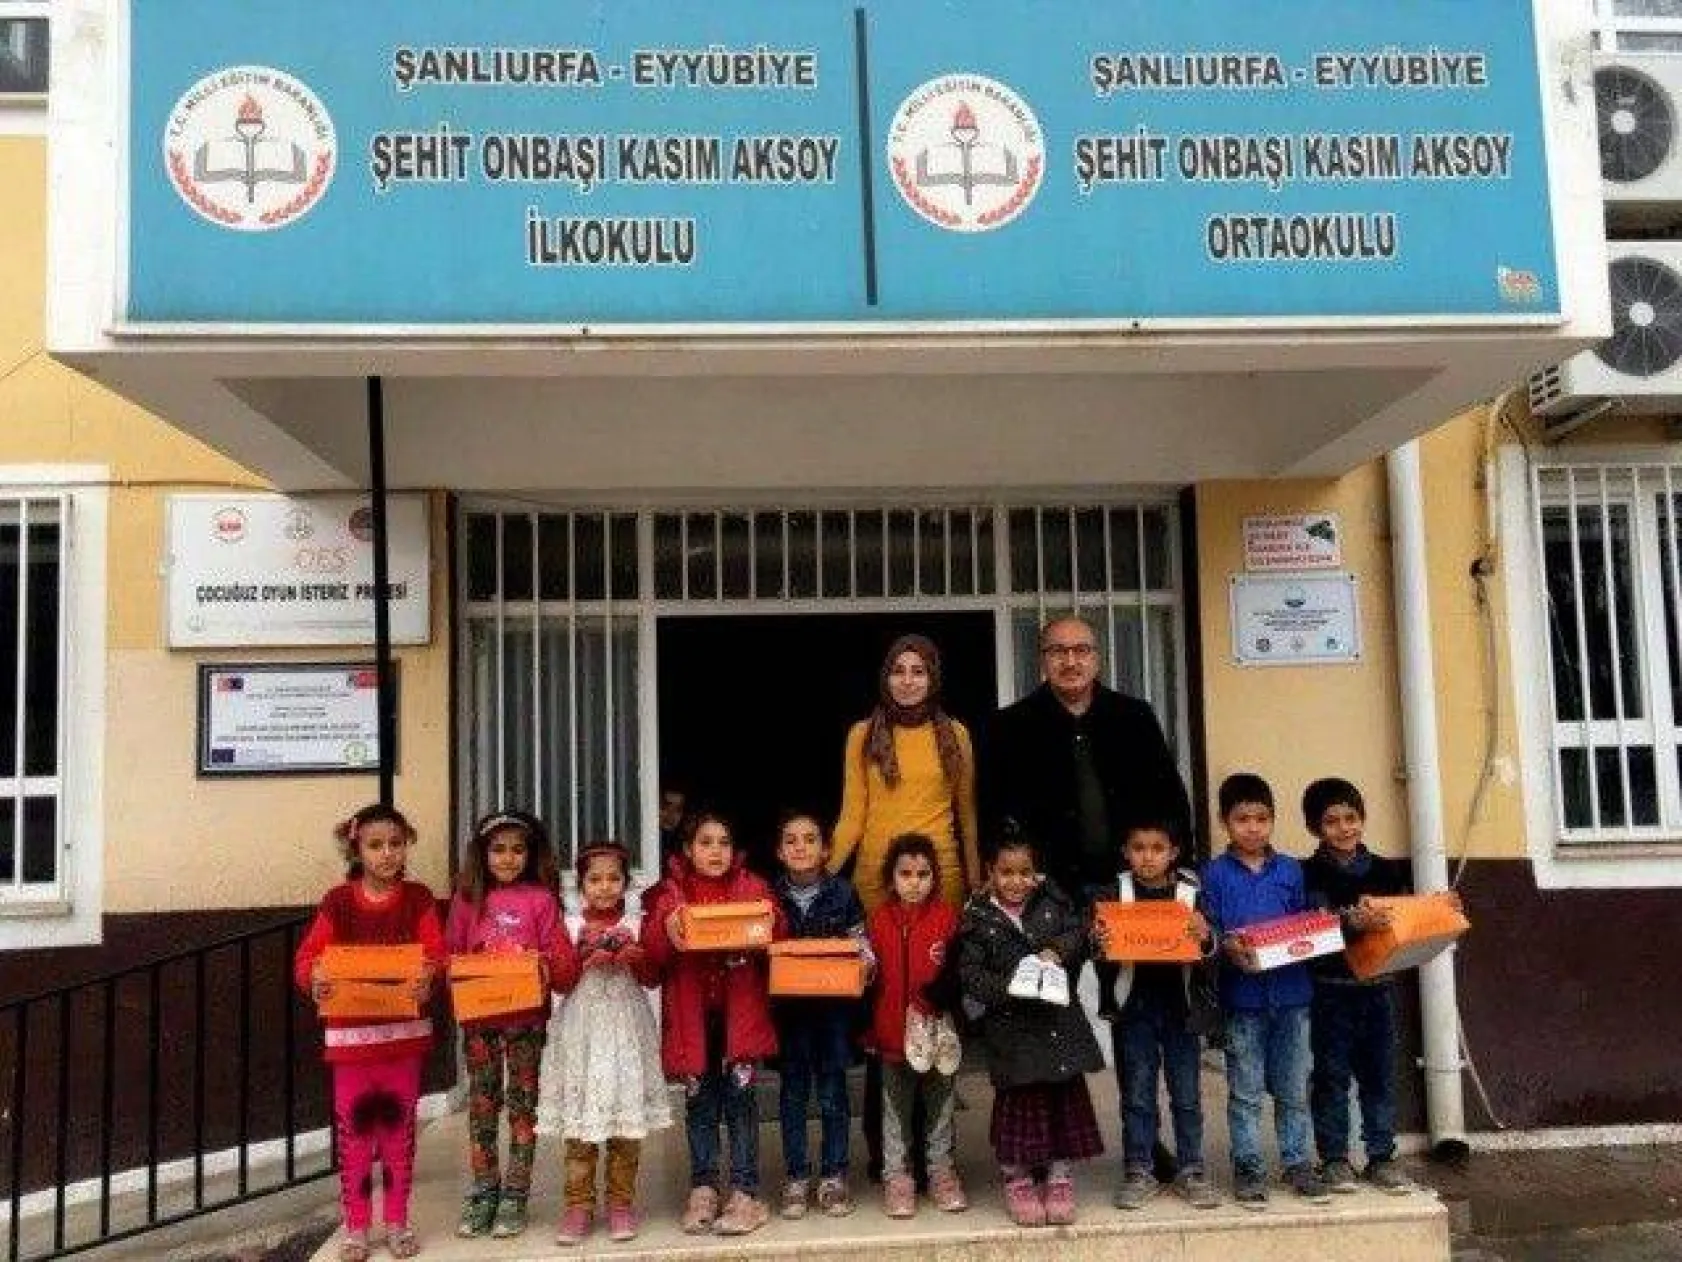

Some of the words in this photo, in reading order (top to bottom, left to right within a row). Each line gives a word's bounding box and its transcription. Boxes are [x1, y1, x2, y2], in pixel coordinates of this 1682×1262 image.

[395, 48, 600, 90] ŞANLIURFA
[634, 46, 815, 86] EYYÜBİYE
[1094, 55, 1284, 90] ŞANLIURFA
[1315, 49, 1486, 86] EYYÜBİYE
[372, 125, 471, 192] ŞEHİT
[483, 135, 606, 192] ONBAŞI
[618, 137, 721, 180] KASIM
[732, 138, 839, 181] AKSOY
[1076, 128, 1166, 190] ŞEHİT
[1179, 135, 1293, 190] ONBAŞI
[1304, 136, 1402, 179] KASIM
[1413, 136, 1510, 177] AKSOY
[528, 210, 696, 264] İLKOKULU
[1207, 213, 1396, 260] ORTAOKULU
[261, 585, 297, 601] OYUN
